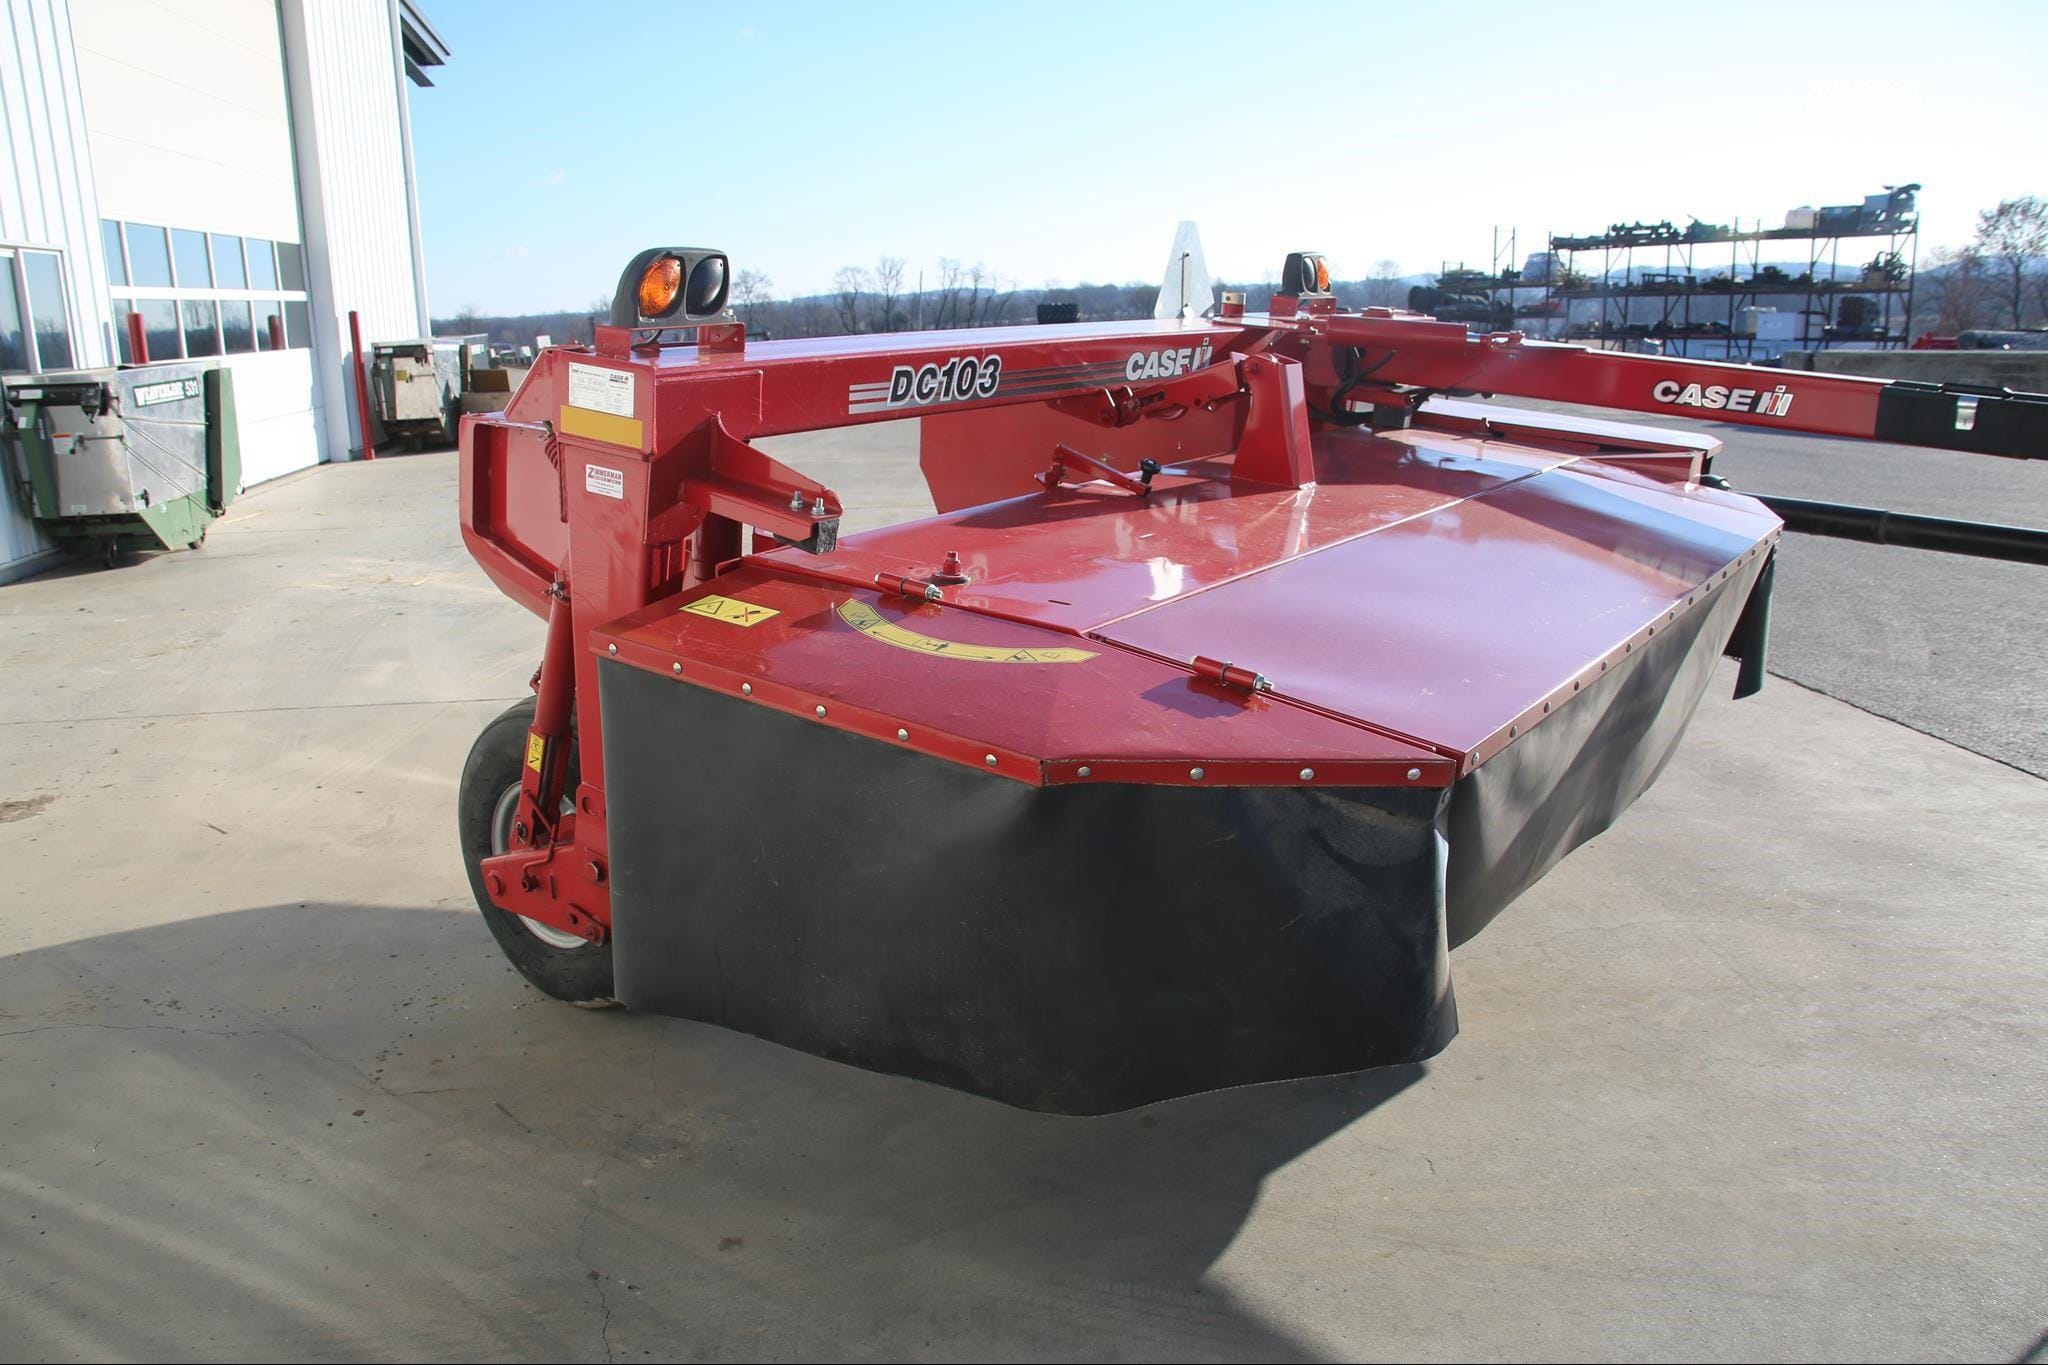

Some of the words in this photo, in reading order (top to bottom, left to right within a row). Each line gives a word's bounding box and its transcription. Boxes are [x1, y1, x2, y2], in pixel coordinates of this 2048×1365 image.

[887, 354, 1001, 406] DC103
[1126, 347, 1193, 381] CASE
[1652, 380, 1757, 412] CASE
[588, 467, 622, 480] ZIMMERMAN
